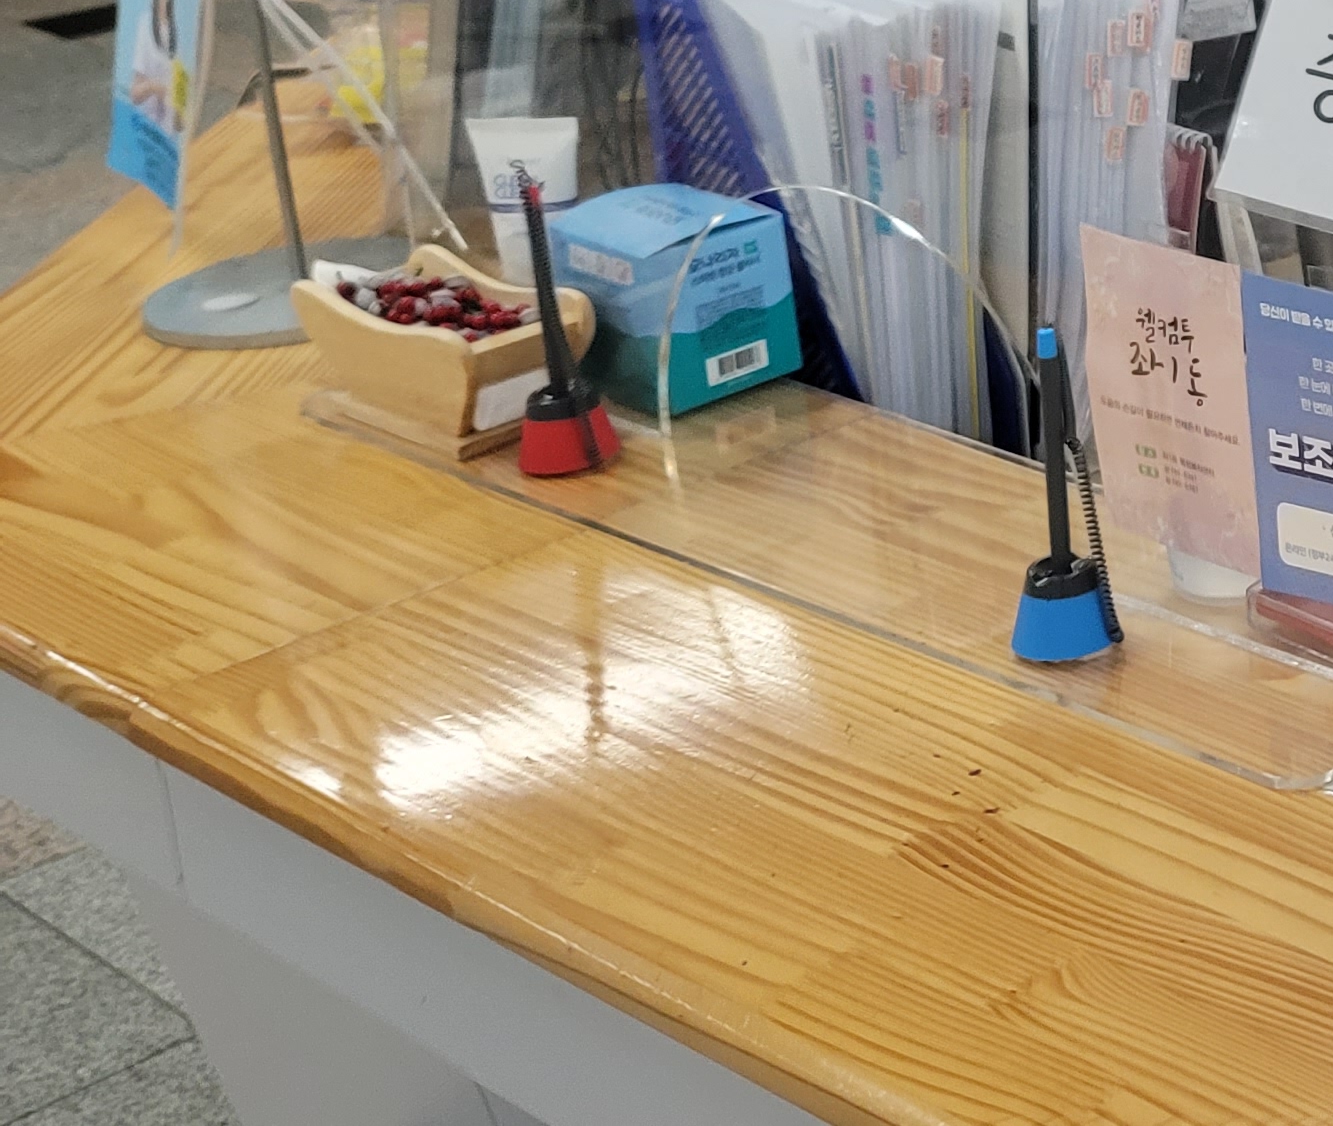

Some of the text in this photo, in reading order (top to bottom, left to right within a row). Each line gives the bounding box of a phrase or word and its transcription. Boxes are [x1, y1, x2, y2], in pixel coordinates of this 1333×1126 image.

[1260, 303, 1289, 321] 당신이
[1312, 315, 1323, 329] 수
[1136, 308, 1194, 354] 웰컴투
[1130, 341, 1208, 407] 좌1동
[1312, 358, 1322, 372] 한
[1299, 376, 1309, 390] 한
[1301, 398, 1311, 412] 한
